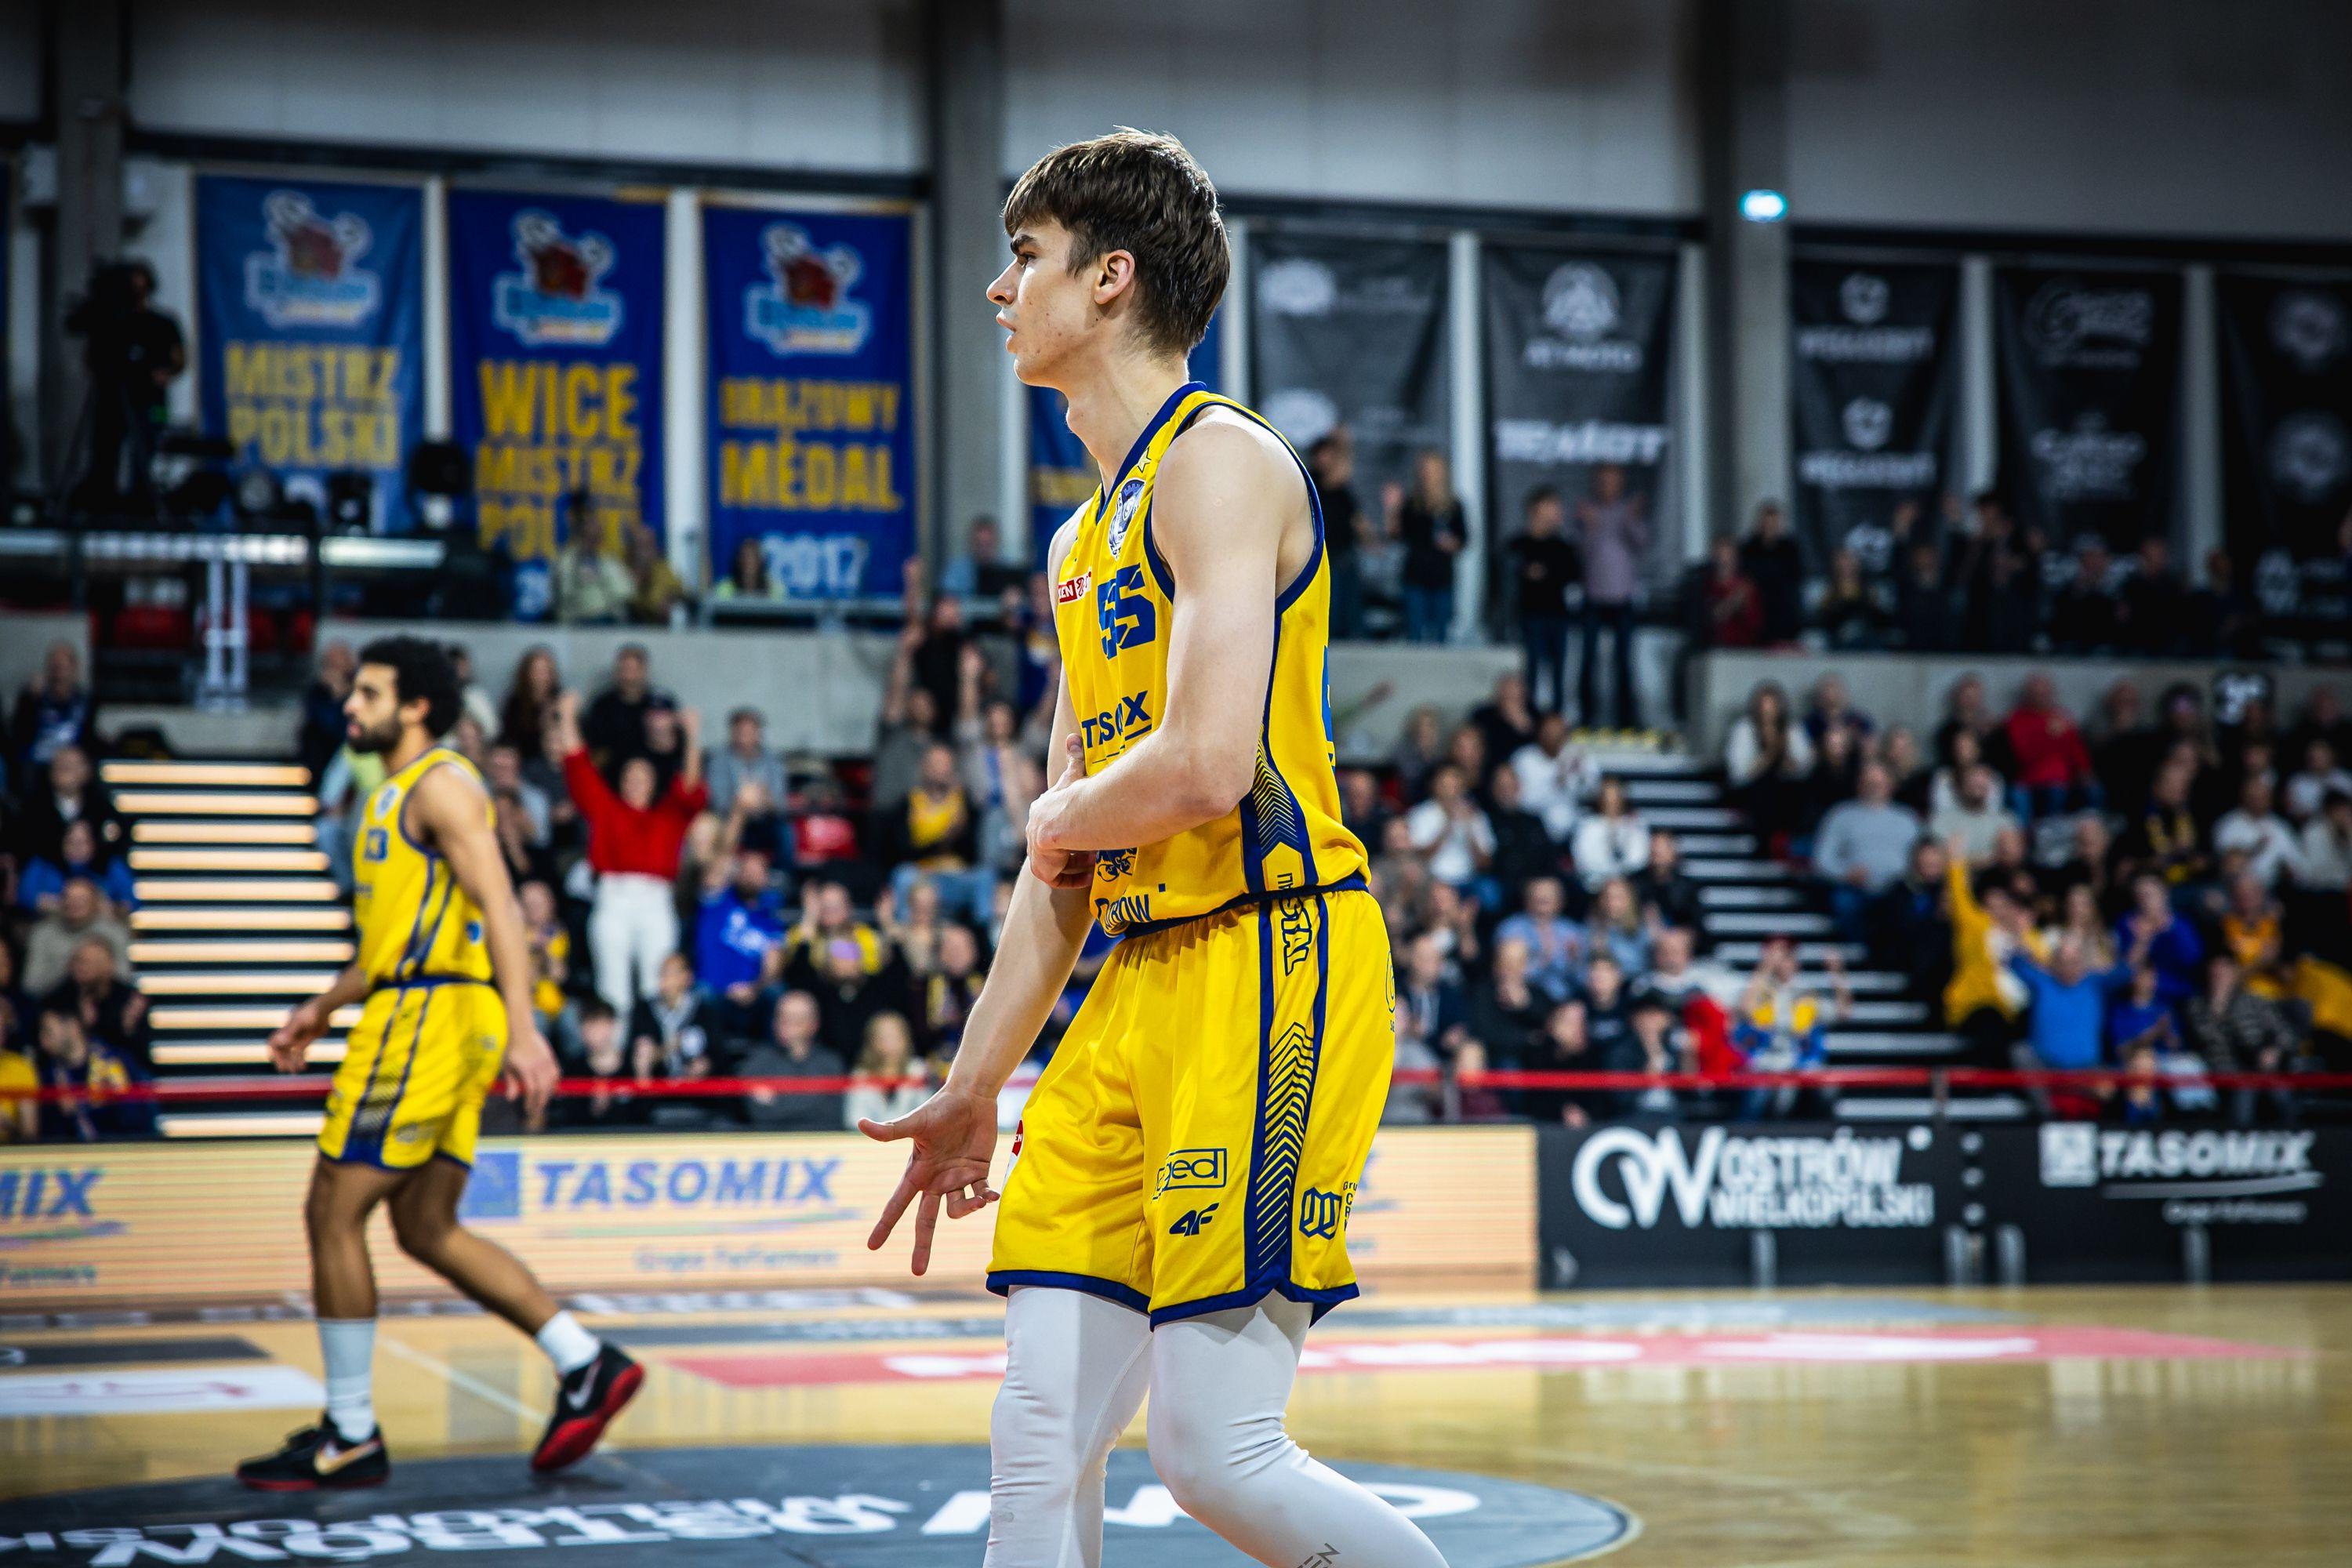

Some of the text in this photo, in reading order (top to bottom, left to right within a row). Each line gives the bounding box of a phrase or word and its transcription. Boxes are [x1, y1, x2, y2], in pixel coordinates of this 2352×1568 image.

[225, 340, 400, 397] MISTRZ
[479, 360, 640, 439] WICE
[228, 405, 398, 468] POLSKI
[1097, 562, 1156, 660] 55
[1719, 1126, 1904, 1185] OSTRÓW
[2099, 1129, 2318, 1176] TASOMIX
[535, 1159, 840, 1207] TASOMIX
[1169, 1203, 1220, 1237] 4F
